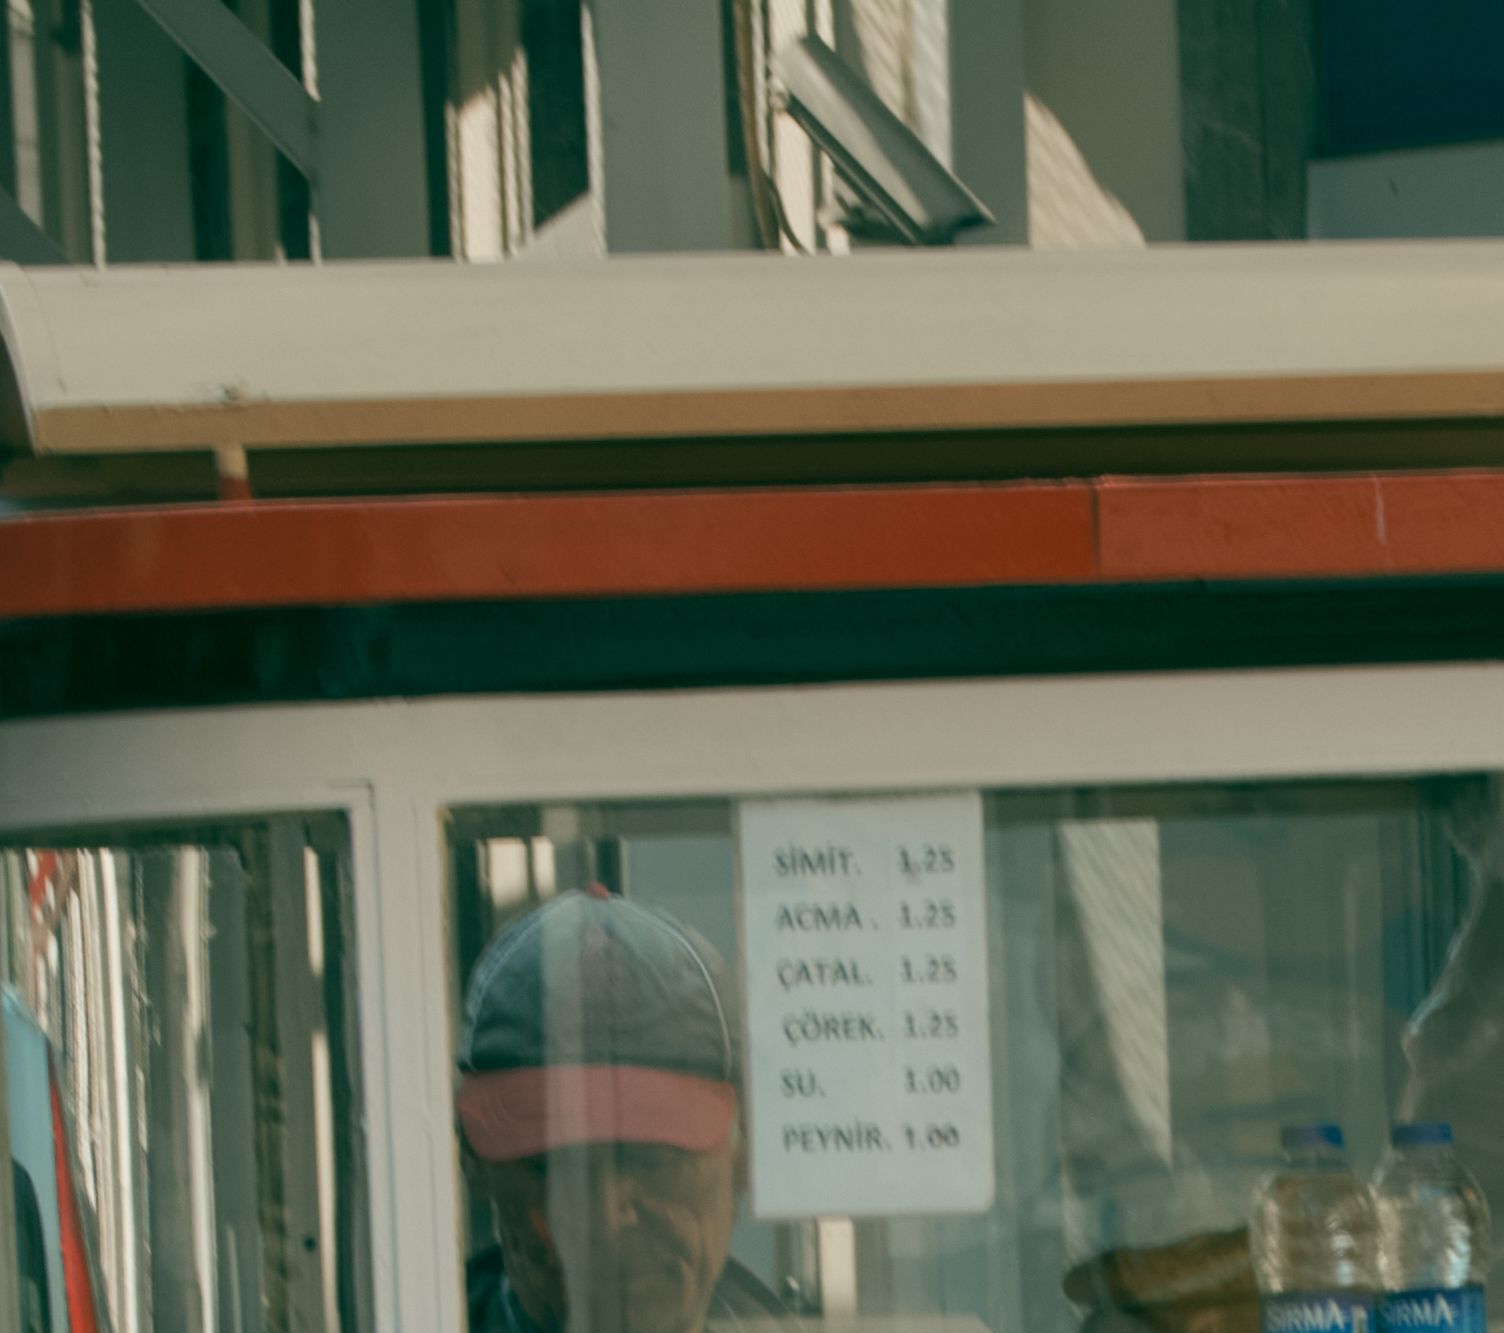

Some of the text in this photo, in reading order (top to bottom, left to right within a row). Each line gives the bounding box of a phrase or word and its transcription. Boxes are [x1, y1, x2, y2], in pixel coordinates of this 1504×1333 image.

[896, 842, 954, 878] 1.25
[899, 901, 955, 930] 1.25
[900, 953, 957, 983] 1.25
[904, 1008, 959, 1038] 1.25
[904, 1065, 960, 1094] 1.00
[904, 1122, 960, 1151] 1.00
